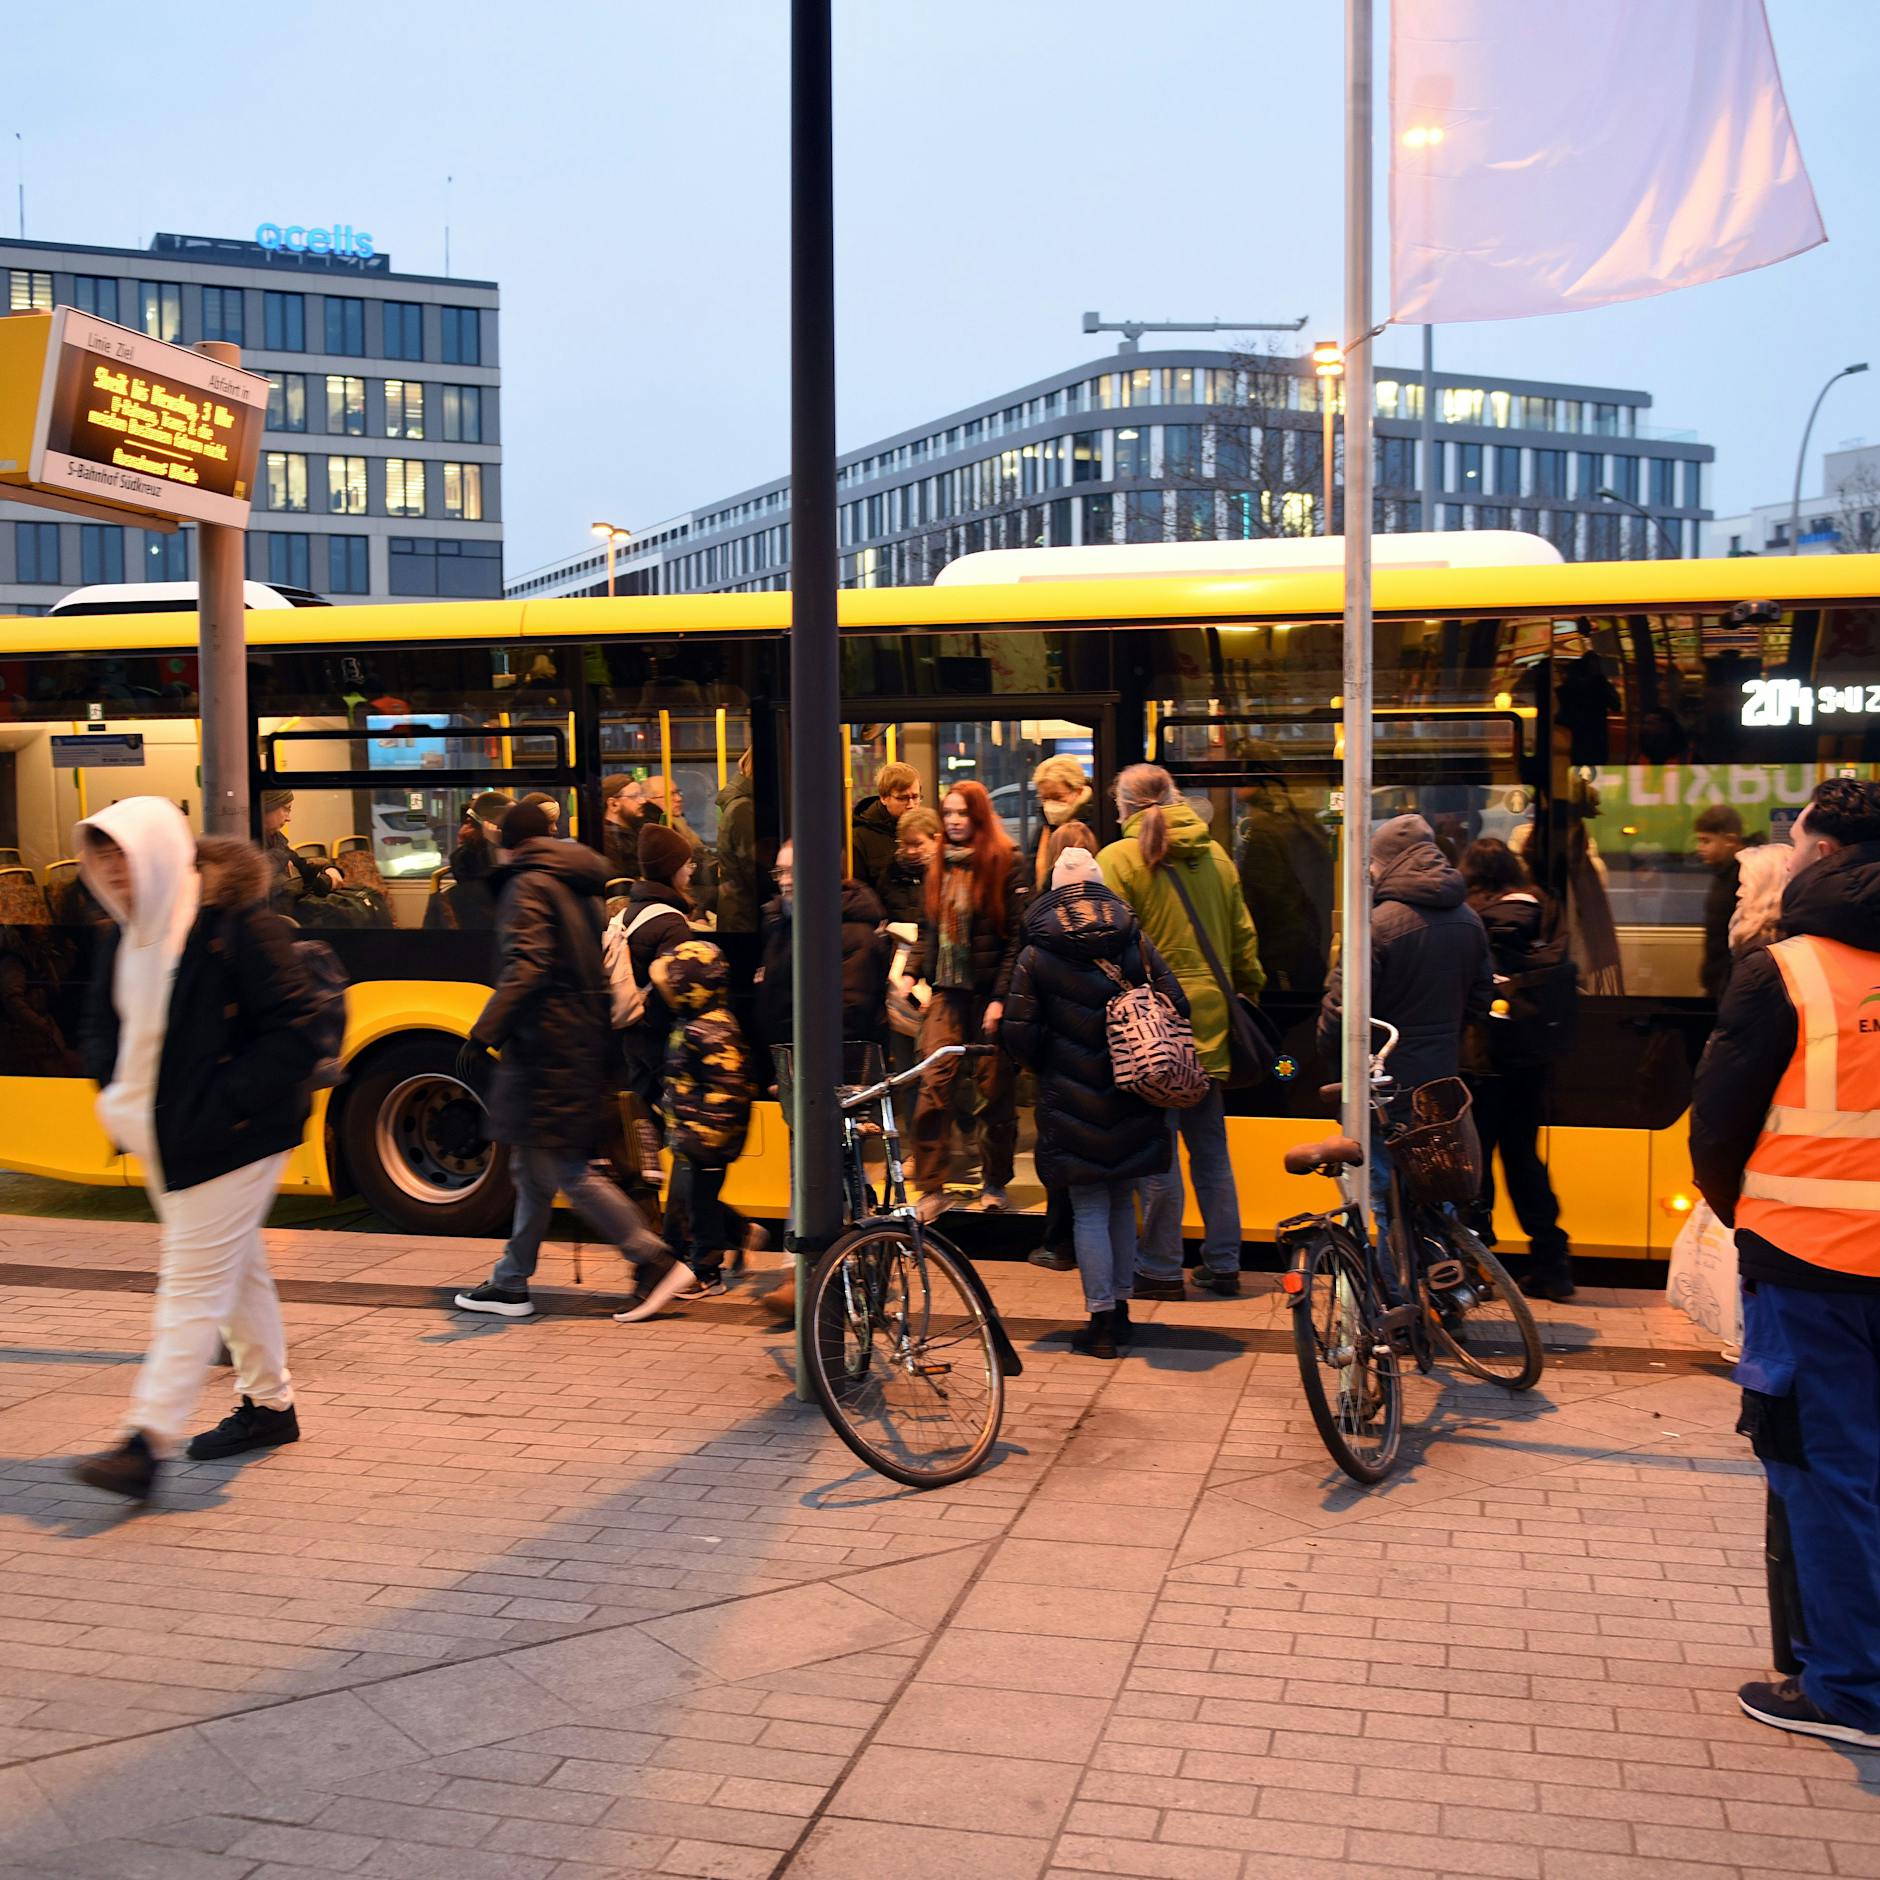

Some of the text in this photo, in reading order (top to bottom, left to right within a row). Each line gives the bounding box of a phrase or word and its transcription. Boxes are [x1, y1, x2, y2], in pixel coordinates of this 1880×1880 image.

[256, 223, 374, 258] Qcells
[88, 332, 135, 361] Linie Ziel
[209, 375, 250, 400] Abfahrt in
[201, 401, 212, 421] 3
[67, 461, 162, 497] S-Bahnhof Südkreuz
[1741, 678, 1814, 726] 204
